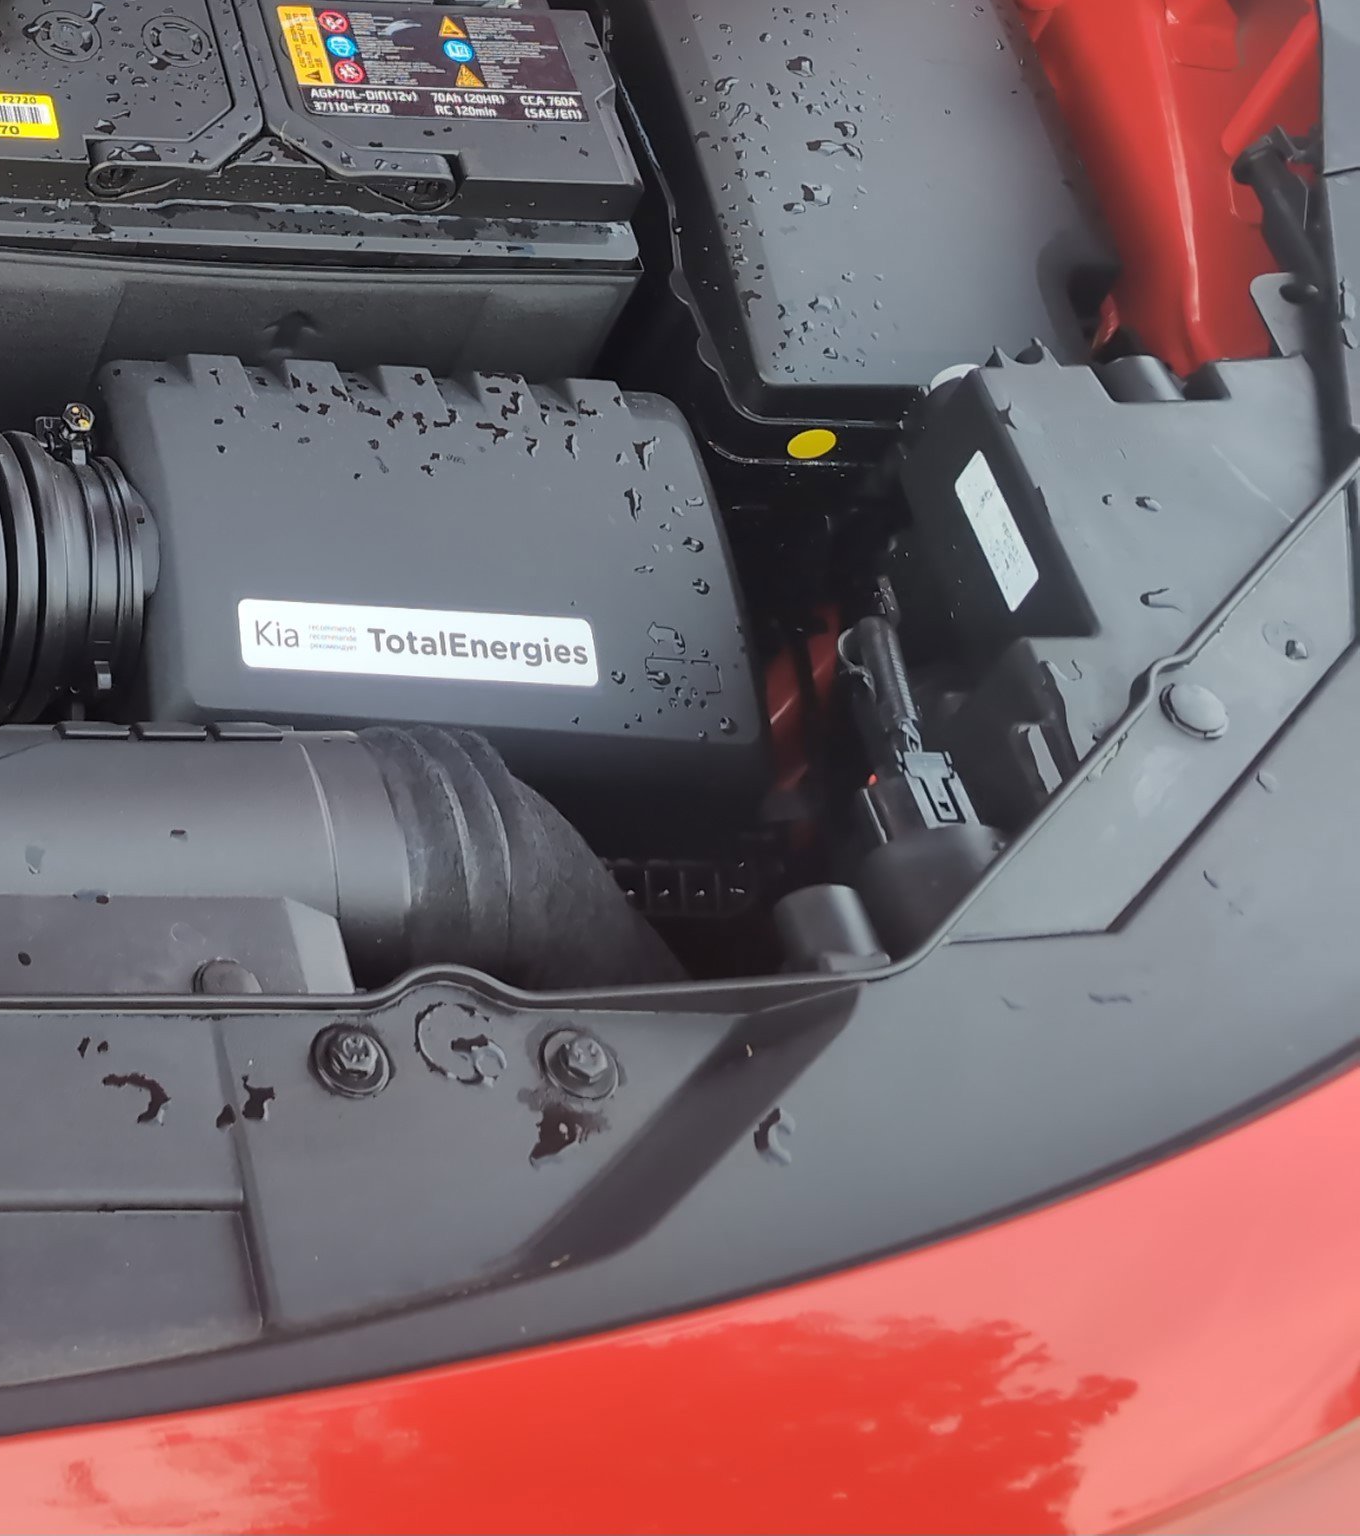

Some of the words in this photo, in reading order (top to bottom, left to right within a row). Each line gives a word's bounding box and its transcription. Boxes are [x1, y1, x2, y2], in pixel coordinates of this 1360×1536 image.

[430, 92, 462, 104] 70Ah
[464, 93, 505, 106] (20HR)
[520, 95, 544, 107] CCA
[546, 97, 578, 108] 760A
[313, 101, 391, 114] 37110-F2720
[435, 104, 453, 116] RC
[455, 105, 497, 118] 120min
[255, 619, 300, 648] Kia
[366, 626, 590, 666] TotalEnergies
